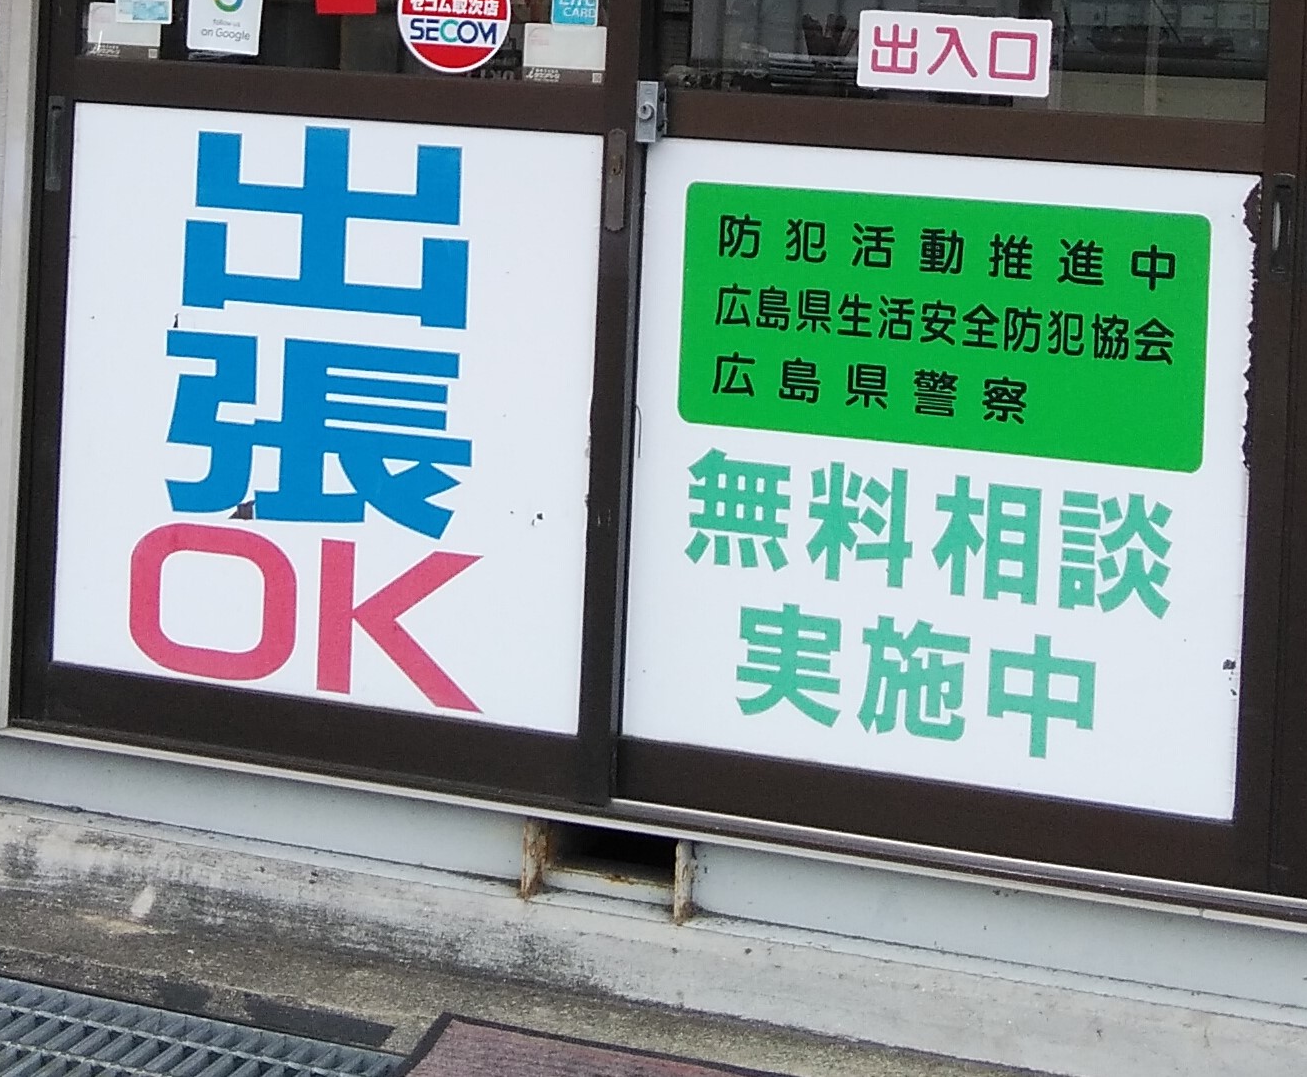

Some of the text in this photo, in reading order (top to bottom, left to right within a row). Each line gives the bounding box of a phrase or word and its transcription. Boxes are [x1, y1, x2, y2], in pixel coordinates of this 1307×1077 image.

[201, 28, 251, 42] on Google
[410, 18, 497, 45] SECOM
[563, 7, 596, 18] CARD
[870, 22, 1038, 81] 出入口
[718, 214, 1177, 291] 防犯活動推進中
[164, 125, 472, 540] 出張
[714, 283, 1175, 366] 広島県生活安全防犯協会
[711, 352, 1028, 424] 広島県警察
[684, 447, 1173, 620] 無料相談
[129, 522, 484, 713] OK
[734, 603, 1096, 760] 実施中
